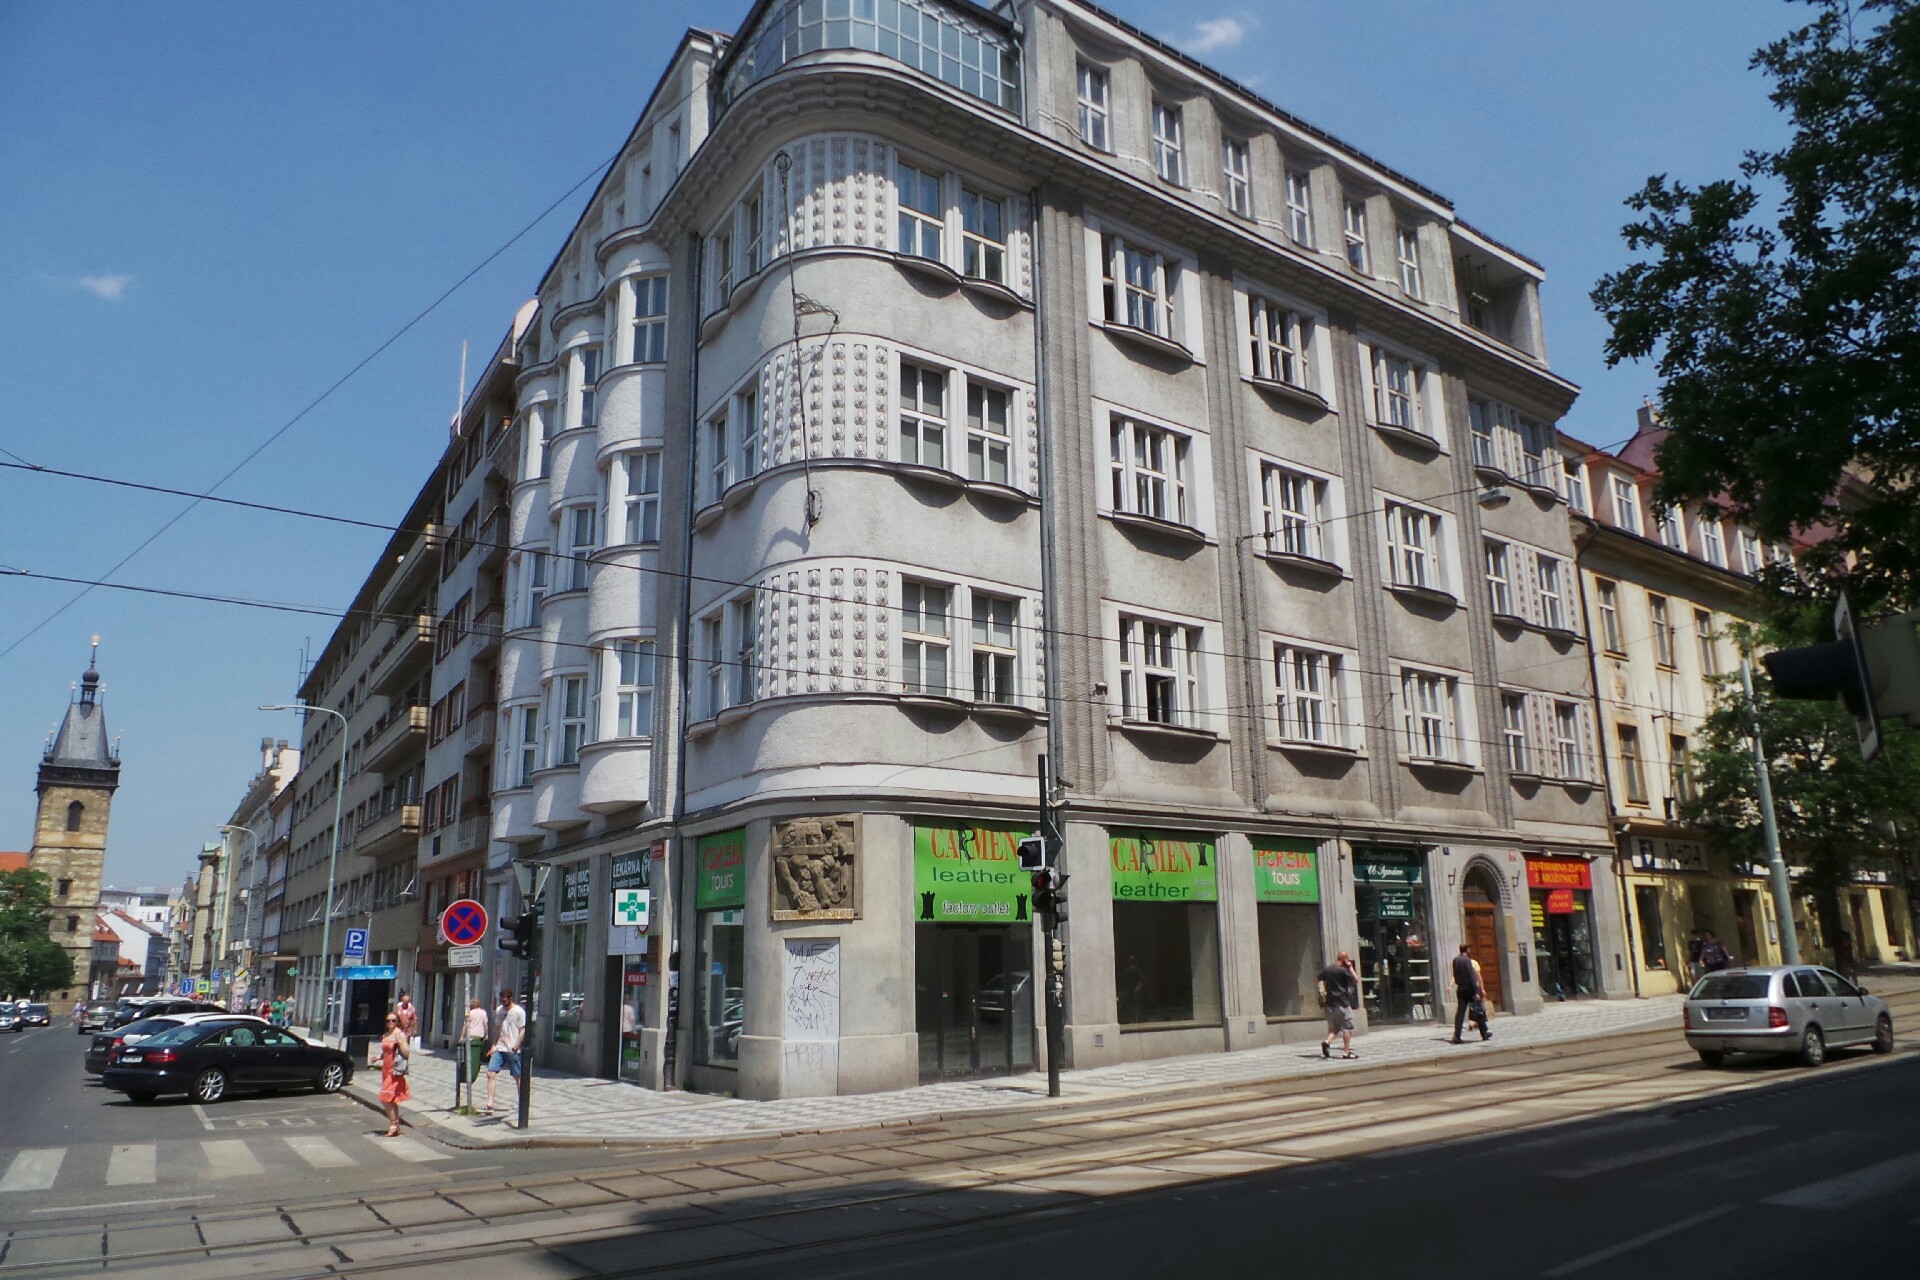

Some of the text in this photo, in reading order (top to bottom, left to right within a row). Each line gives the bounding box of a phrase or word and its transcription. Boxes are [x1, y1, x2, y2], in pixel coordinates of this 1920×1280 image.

[931, 821, 1019, 866] CARMEN
[1113, 834, 1193, 878] CARMEN
[612, 857, 641, 878] LÉKÁRNA
[933, 867, 1016, 884] leather
[711, 872, 734, 891] tours
[1272, 871, 1301, 886] tours
[1114, 882, 1190, 897] leather
[943, 900, 1010, 917] factory outlet
[348, 932, 363, 948] P
